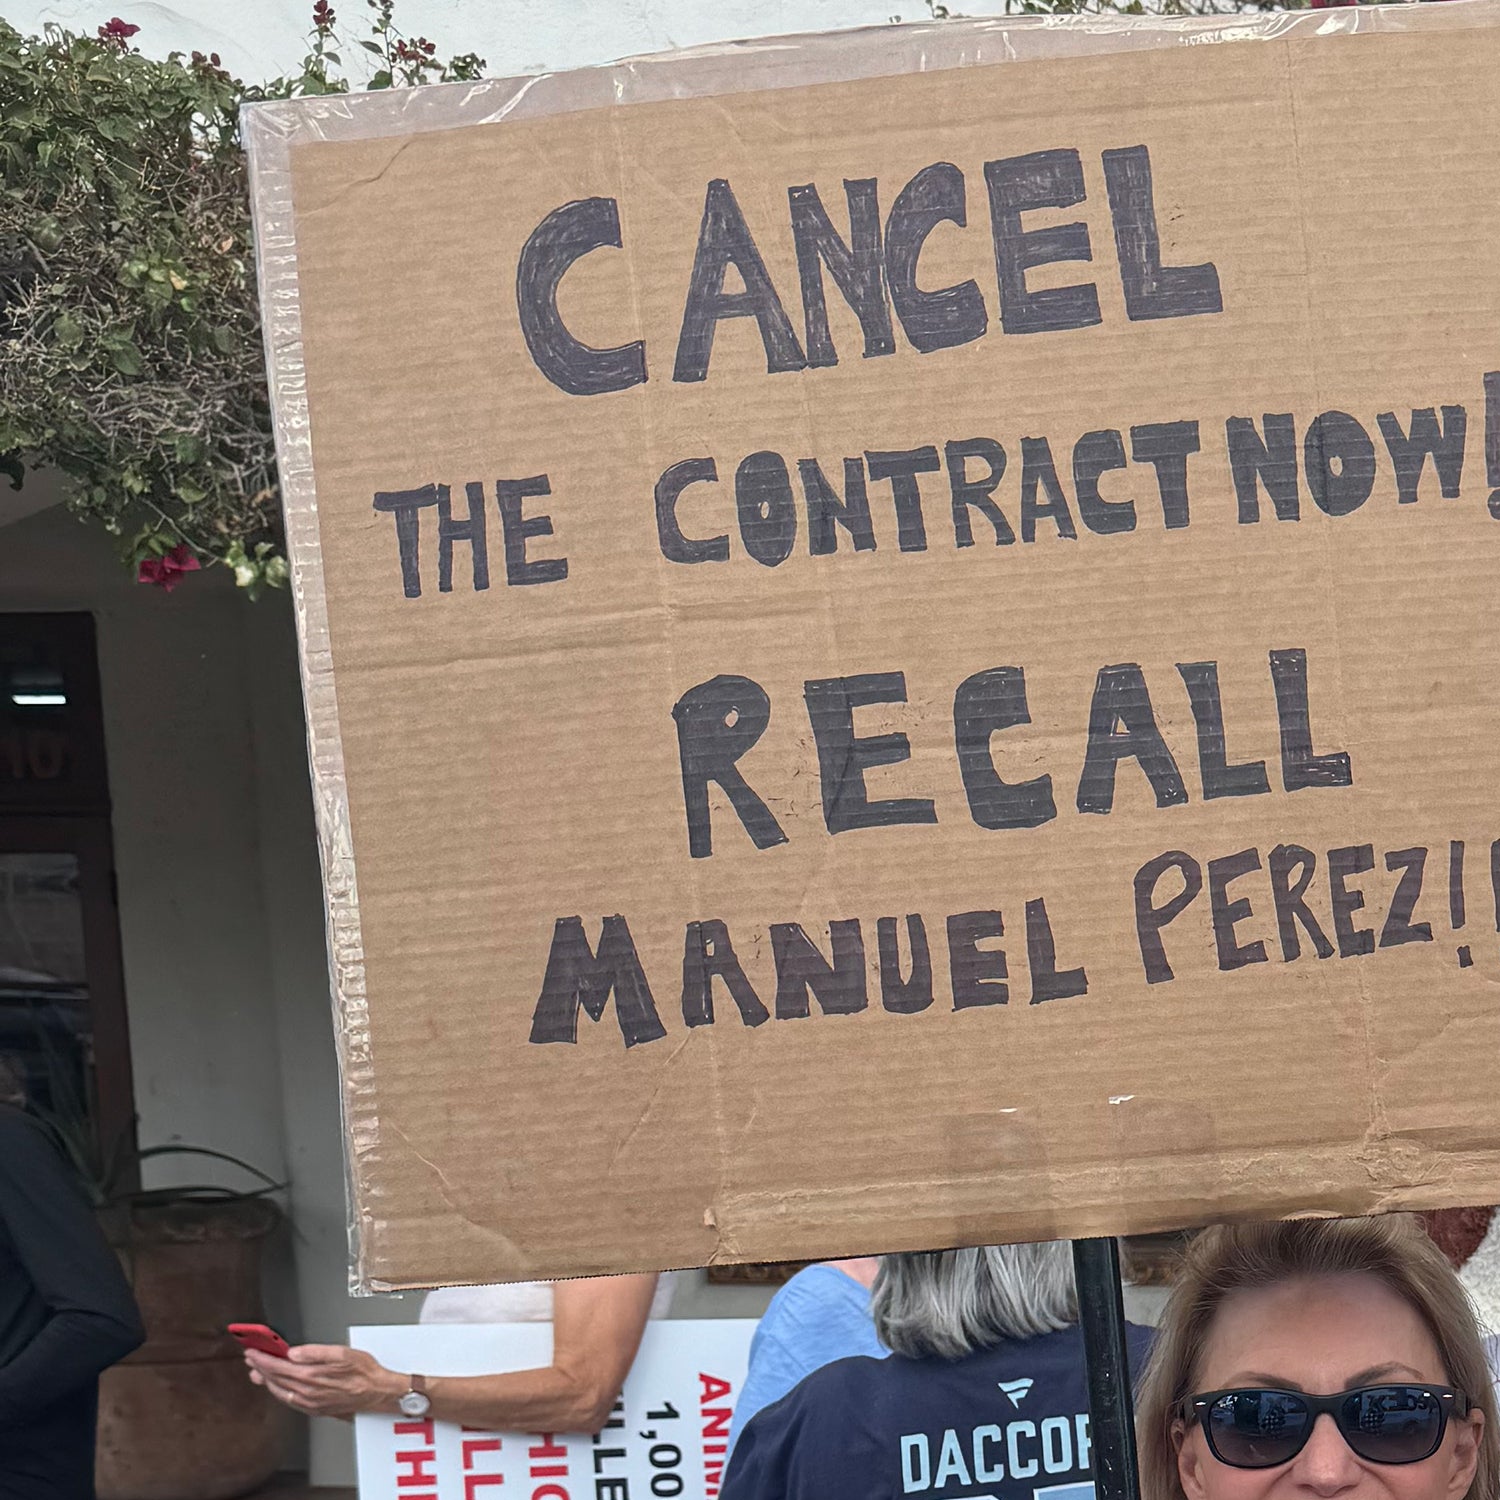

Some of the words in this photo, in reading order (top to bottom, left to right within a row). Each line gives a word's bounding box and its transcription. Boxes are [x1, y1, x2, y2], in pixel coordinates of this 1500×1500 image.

[515, 144, 1224, 396] CANCEL
[373, 474, 569, 599] THE
[654, 419, 1201, 568] CONTRACT
[671, 648, 1352, 860] RECALL
[529, 897, 1089, 1049] MANUEL
